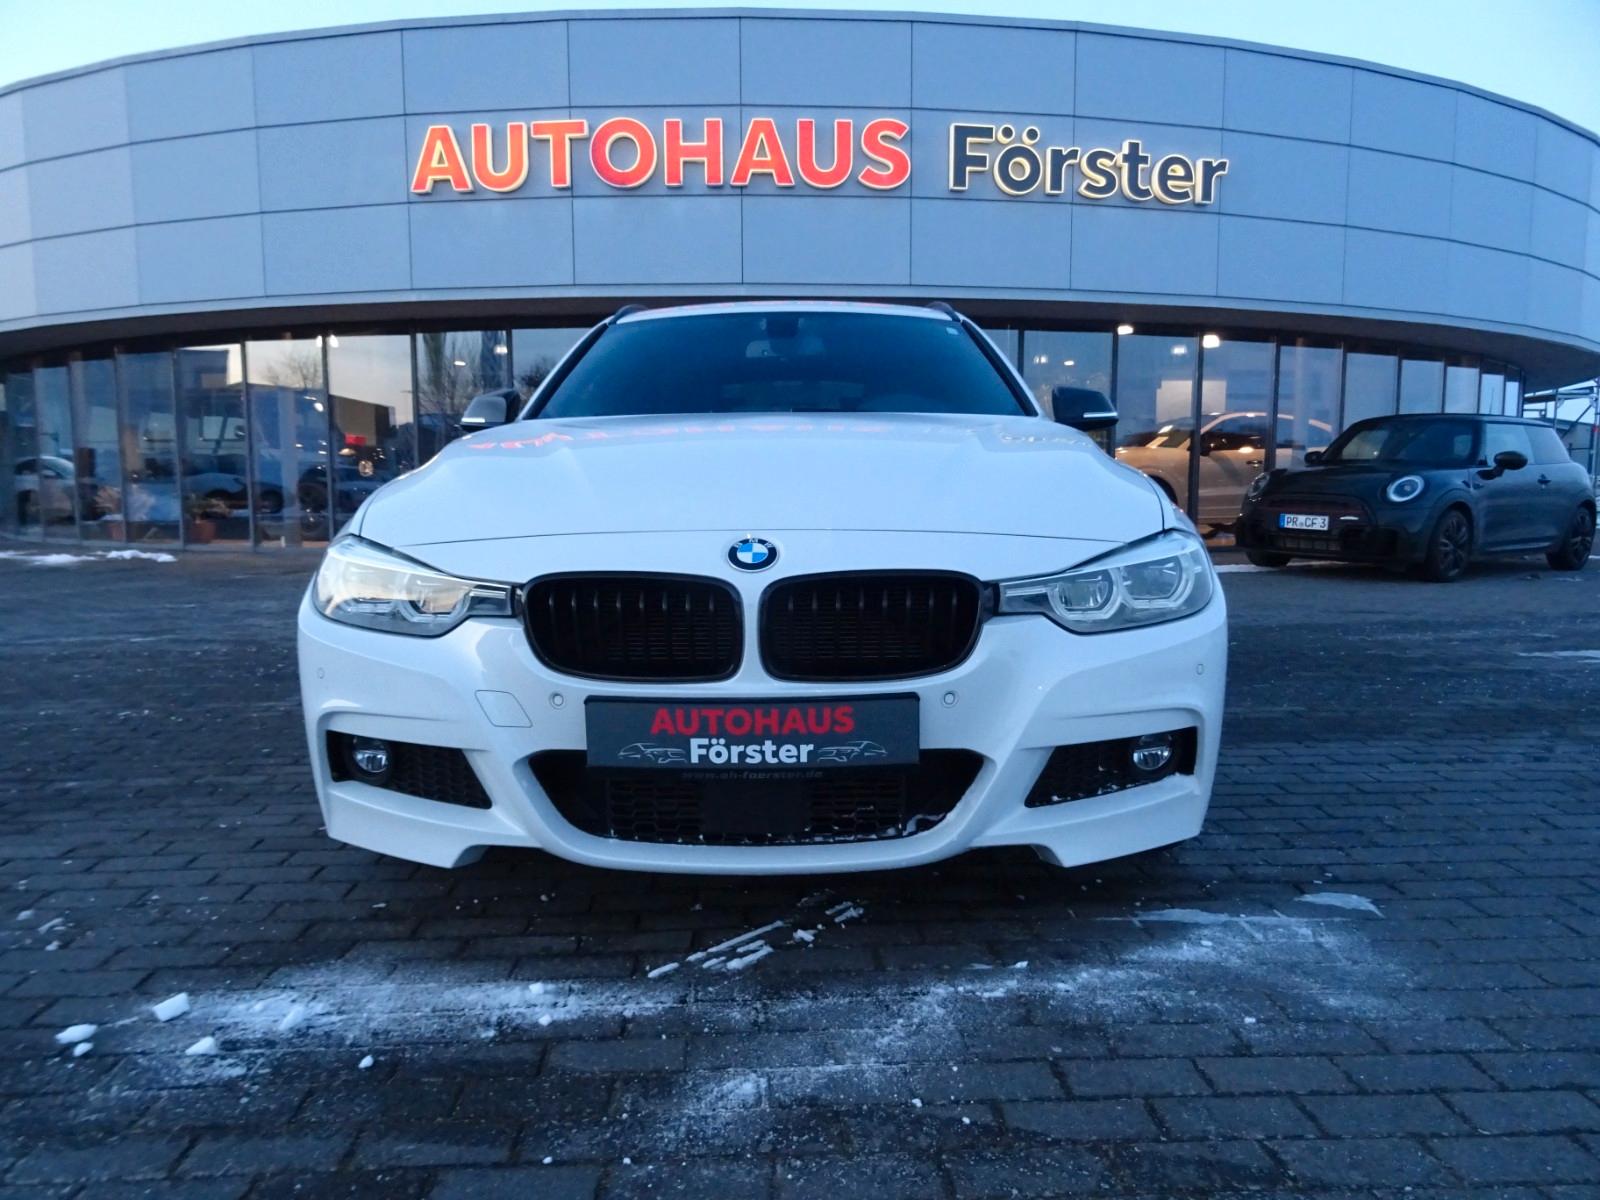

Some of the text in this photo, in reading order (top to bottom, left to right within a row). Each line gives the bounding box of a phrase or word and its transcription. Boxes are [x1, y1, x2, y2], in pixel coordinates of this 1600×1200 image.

[411, 117, 1228, 206] AUTOHAUS Förster
[1286, 516, 1327, 529] PR CF 3
[652, 706, 855, 736] AUTOHAUS
[690, 738, 815, 764] Förster
